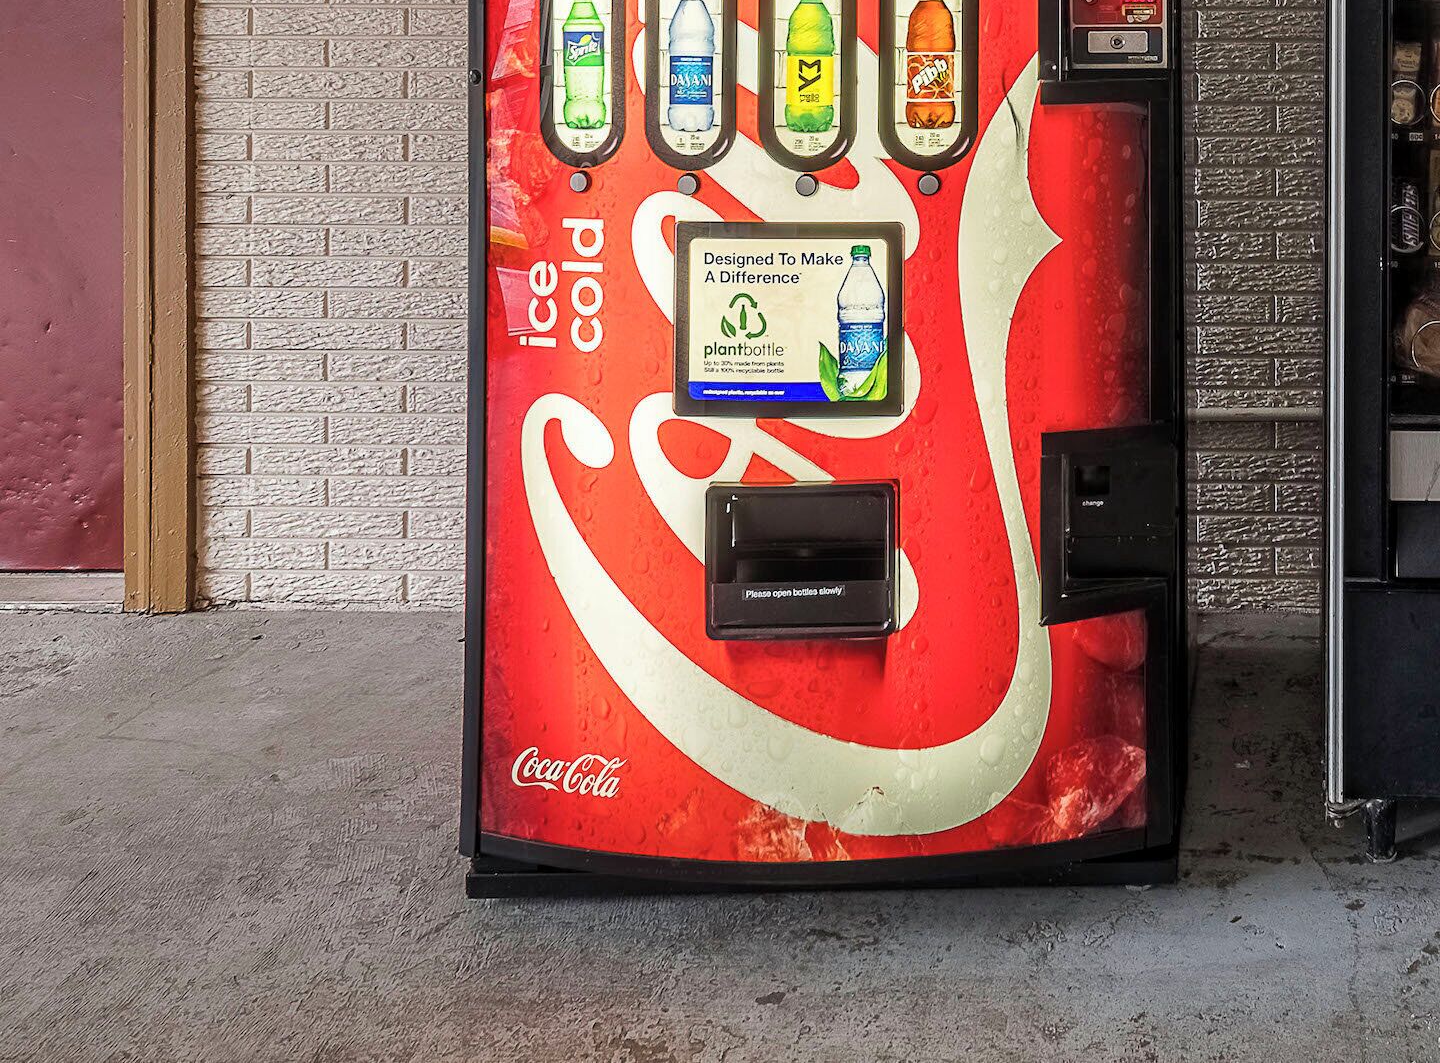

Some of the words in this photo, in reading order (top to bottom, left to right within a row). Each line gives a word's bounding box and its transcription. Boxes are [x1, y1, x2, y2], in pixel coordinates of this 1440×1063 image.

[569, 41, 598, 61] Sprite
[671, 72, 712, 88] DASANI
[911, 58, 949, 96] Pibb
[704, 252, 774, 268] Designed
[778, 252, 796, 265] To
[801, 252, 843, 265] Make
[705, 271, 715, 283] A
[720, 270, 800, 284] Difference
[561, 218, 604, 353] cold
[519, 261, 558, 348] ice
[704, 342, 784, 358] plantbottle
[840, 341, 884, 354] DASANI
[736, 367, 765, 375] recyclable
[1082, 499, 1104, 507] change
[746, 590, 771, 599] Please
[772, 589, 791, 598] open
[793, 588, 818, 597] bottles
[819, 586, 843, 596] slowly
[512, 746, 627, 798] Coca-Cola
